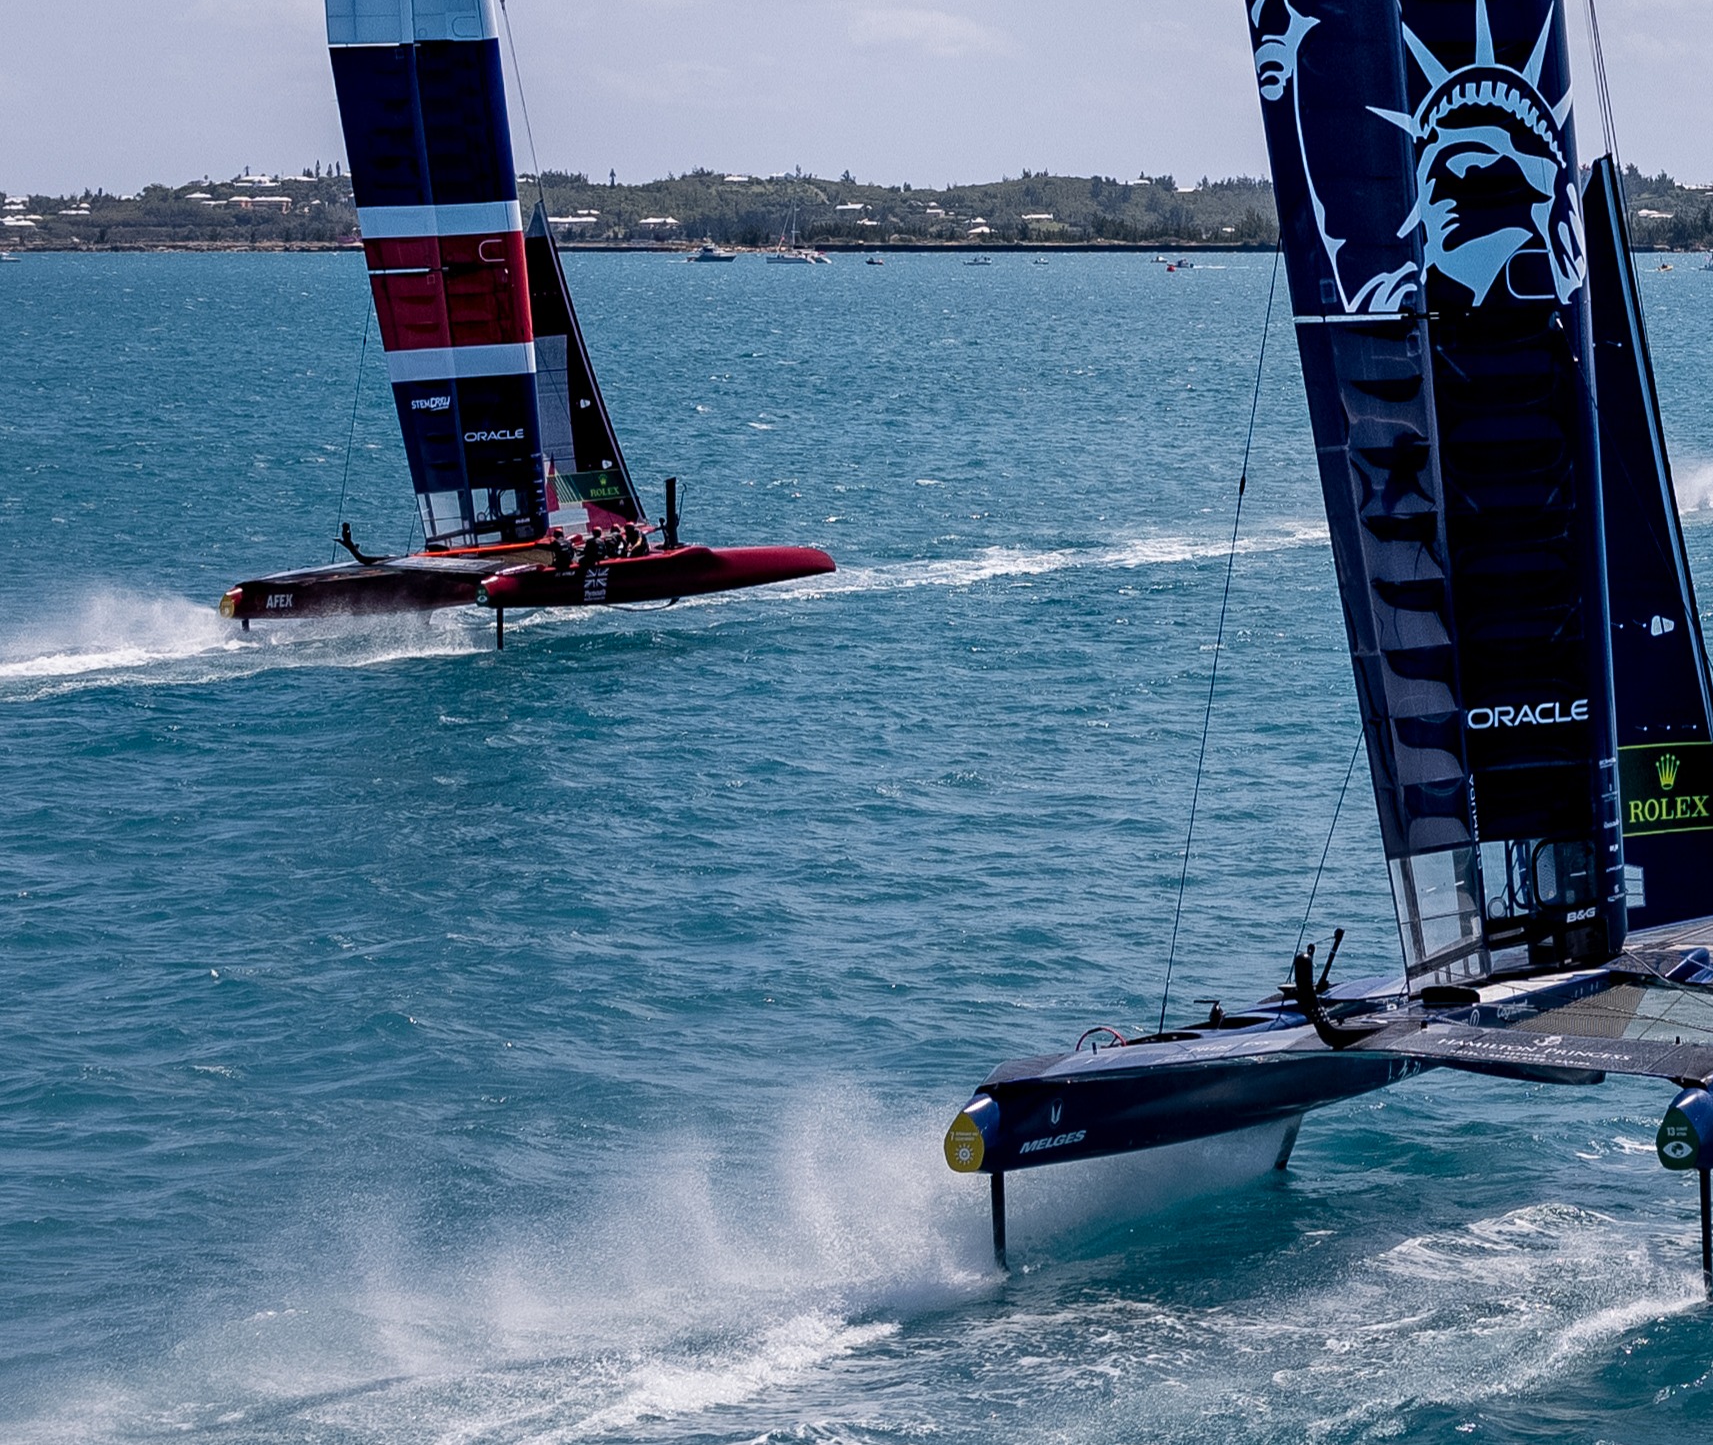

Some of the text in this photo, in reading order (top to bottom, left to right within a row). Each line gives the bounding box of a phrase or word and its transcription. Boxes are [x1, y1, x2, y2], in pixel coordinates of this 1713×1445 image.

[464, 428, 524, 442] ORACLE
[590, 486, 619, 497] ROLEX
[1467, 699, 1589, 729] ORACLE
[1629, 795, 1710, 823] ROLEX
[1566, 907, 1596, 923] B&G
[1437, 1038, 1537, 1053] HAMILTON
[1019, 1130, 1086, 1154] MELGES
